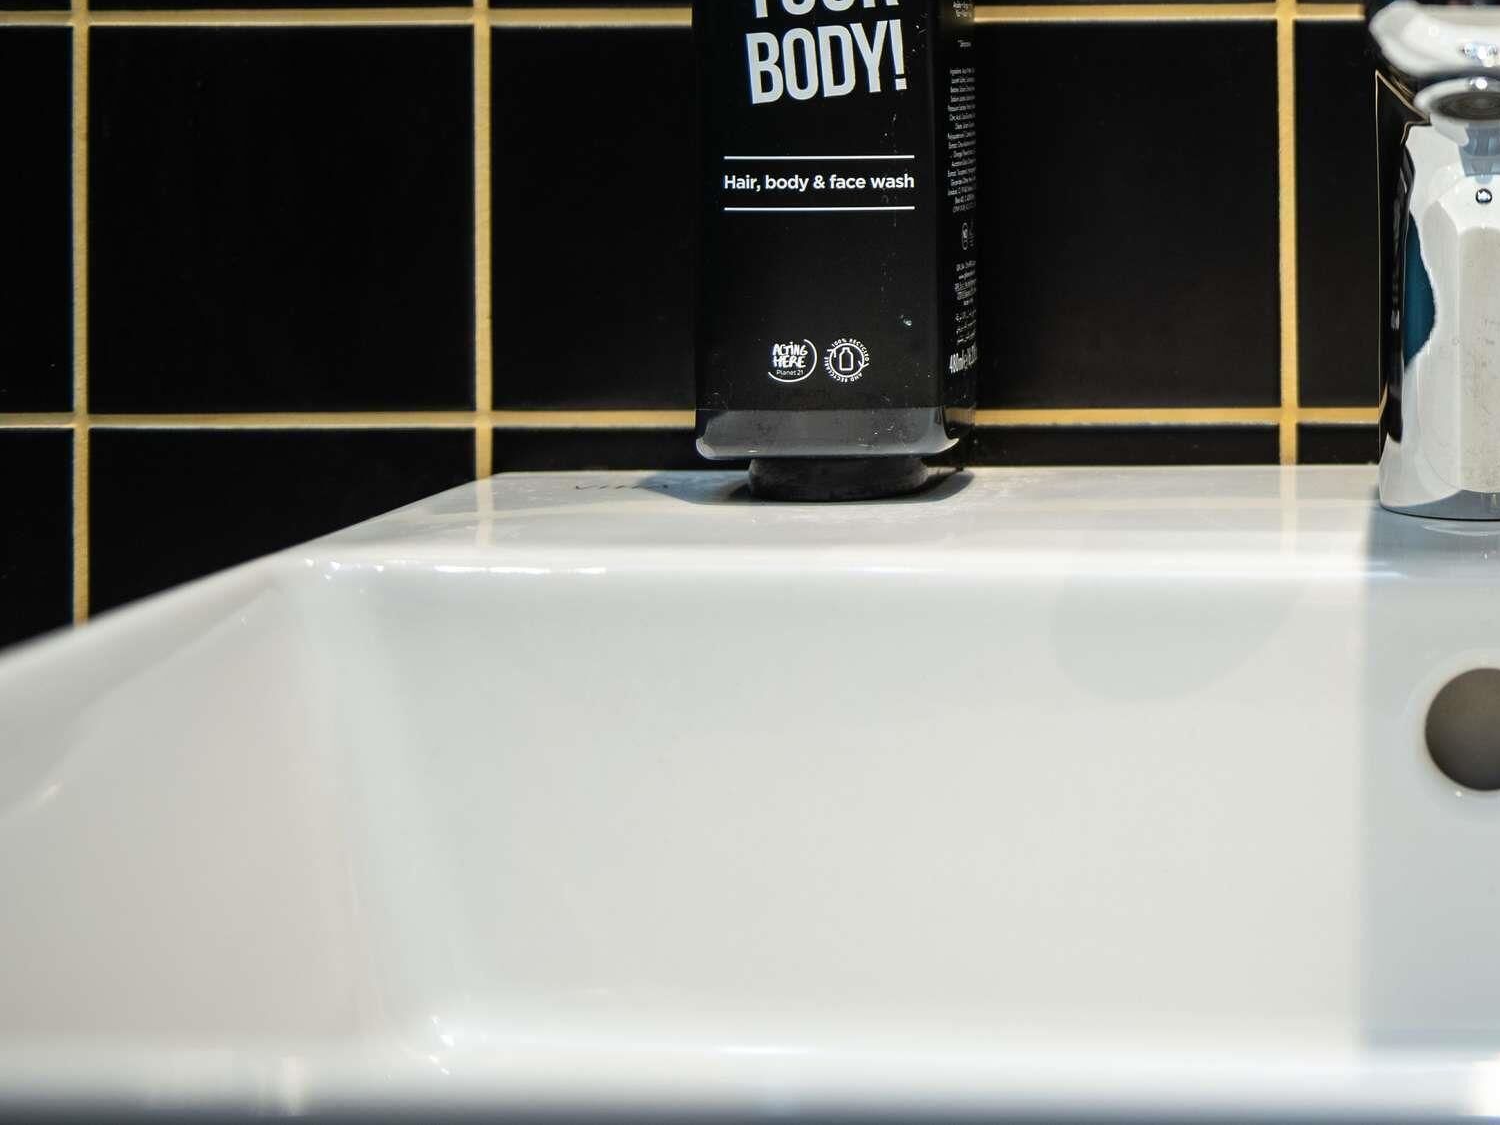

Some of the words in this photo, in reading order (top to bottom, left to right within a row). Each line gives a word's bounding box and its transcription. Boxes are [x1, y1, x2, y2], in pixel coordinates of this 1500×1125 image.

[745, 18, 908, 105] BODY!
[723, 174, 761, 193] Hair,
[765, 174, 810, 193] body
[813, 175, 826, 190] &
[829, 174, 867, 190] face
[870, 174, 915, 189] wash
[772, 355, 807, 368] HERE
